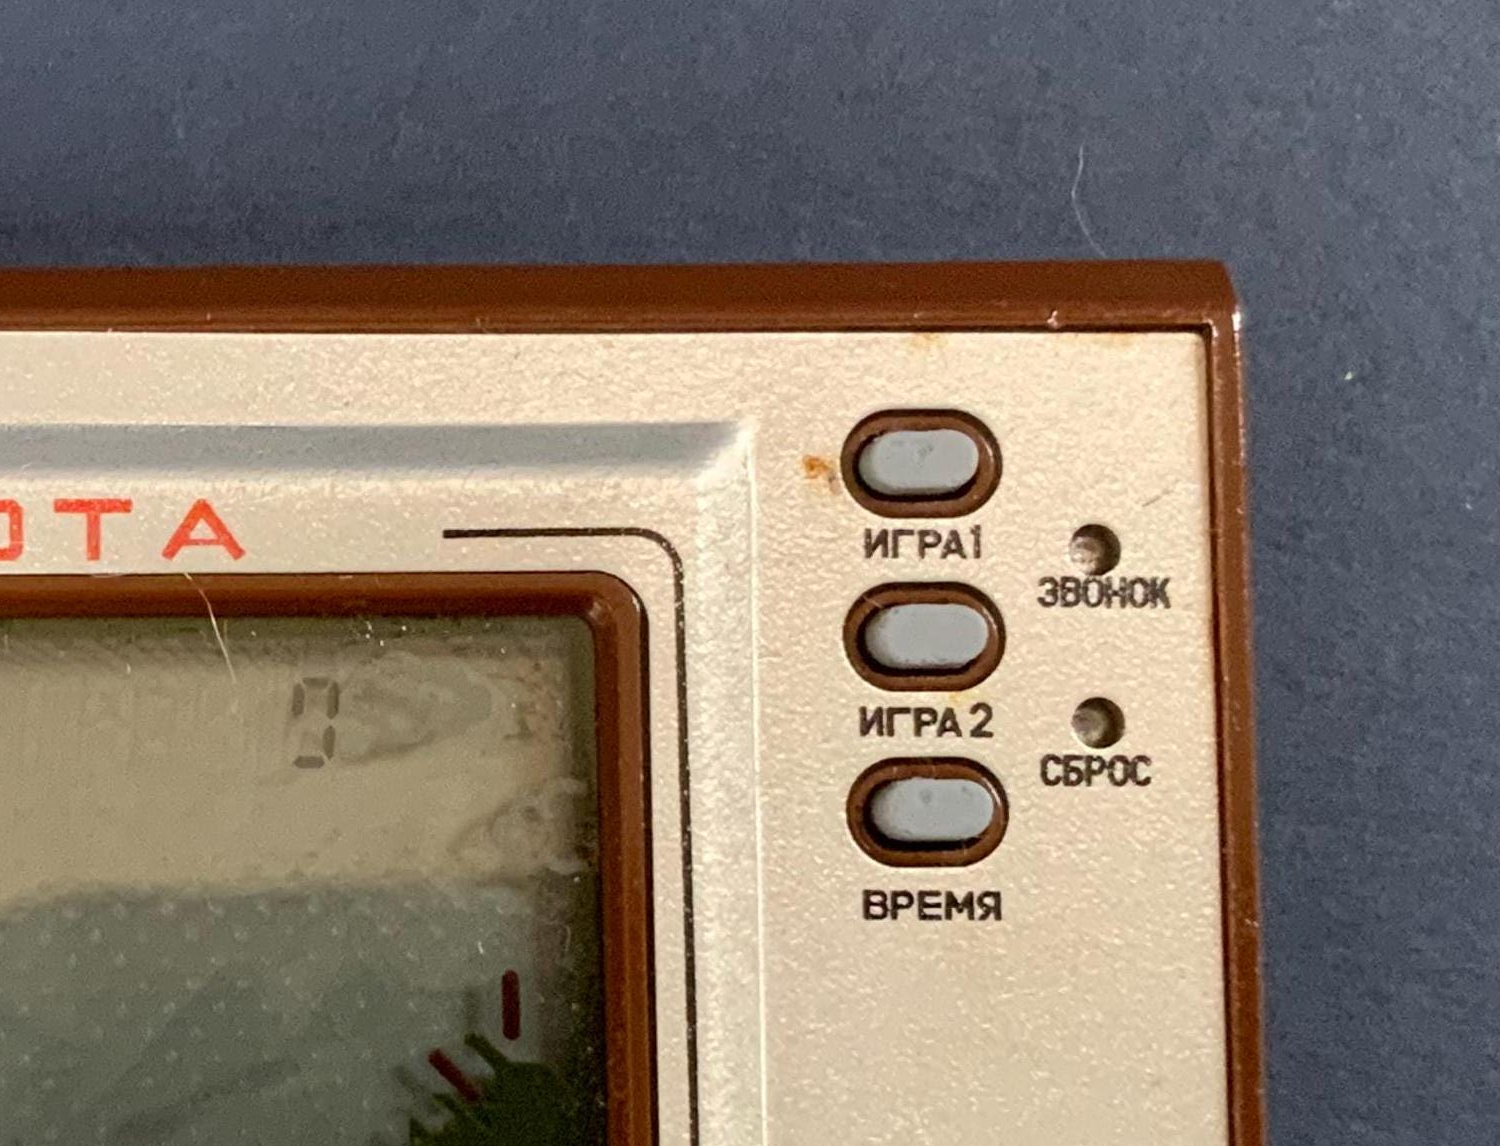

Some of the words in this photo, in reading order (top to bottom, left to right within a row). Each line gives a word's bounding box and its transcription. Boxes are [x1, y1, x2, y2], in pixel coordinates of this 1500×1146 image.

[1037, 576, 1171, 609] ЗВОНОК
[1040, 754, 1152, 787] СБРОС
[862, 889, 1003, 921] ВРЕМЯ
